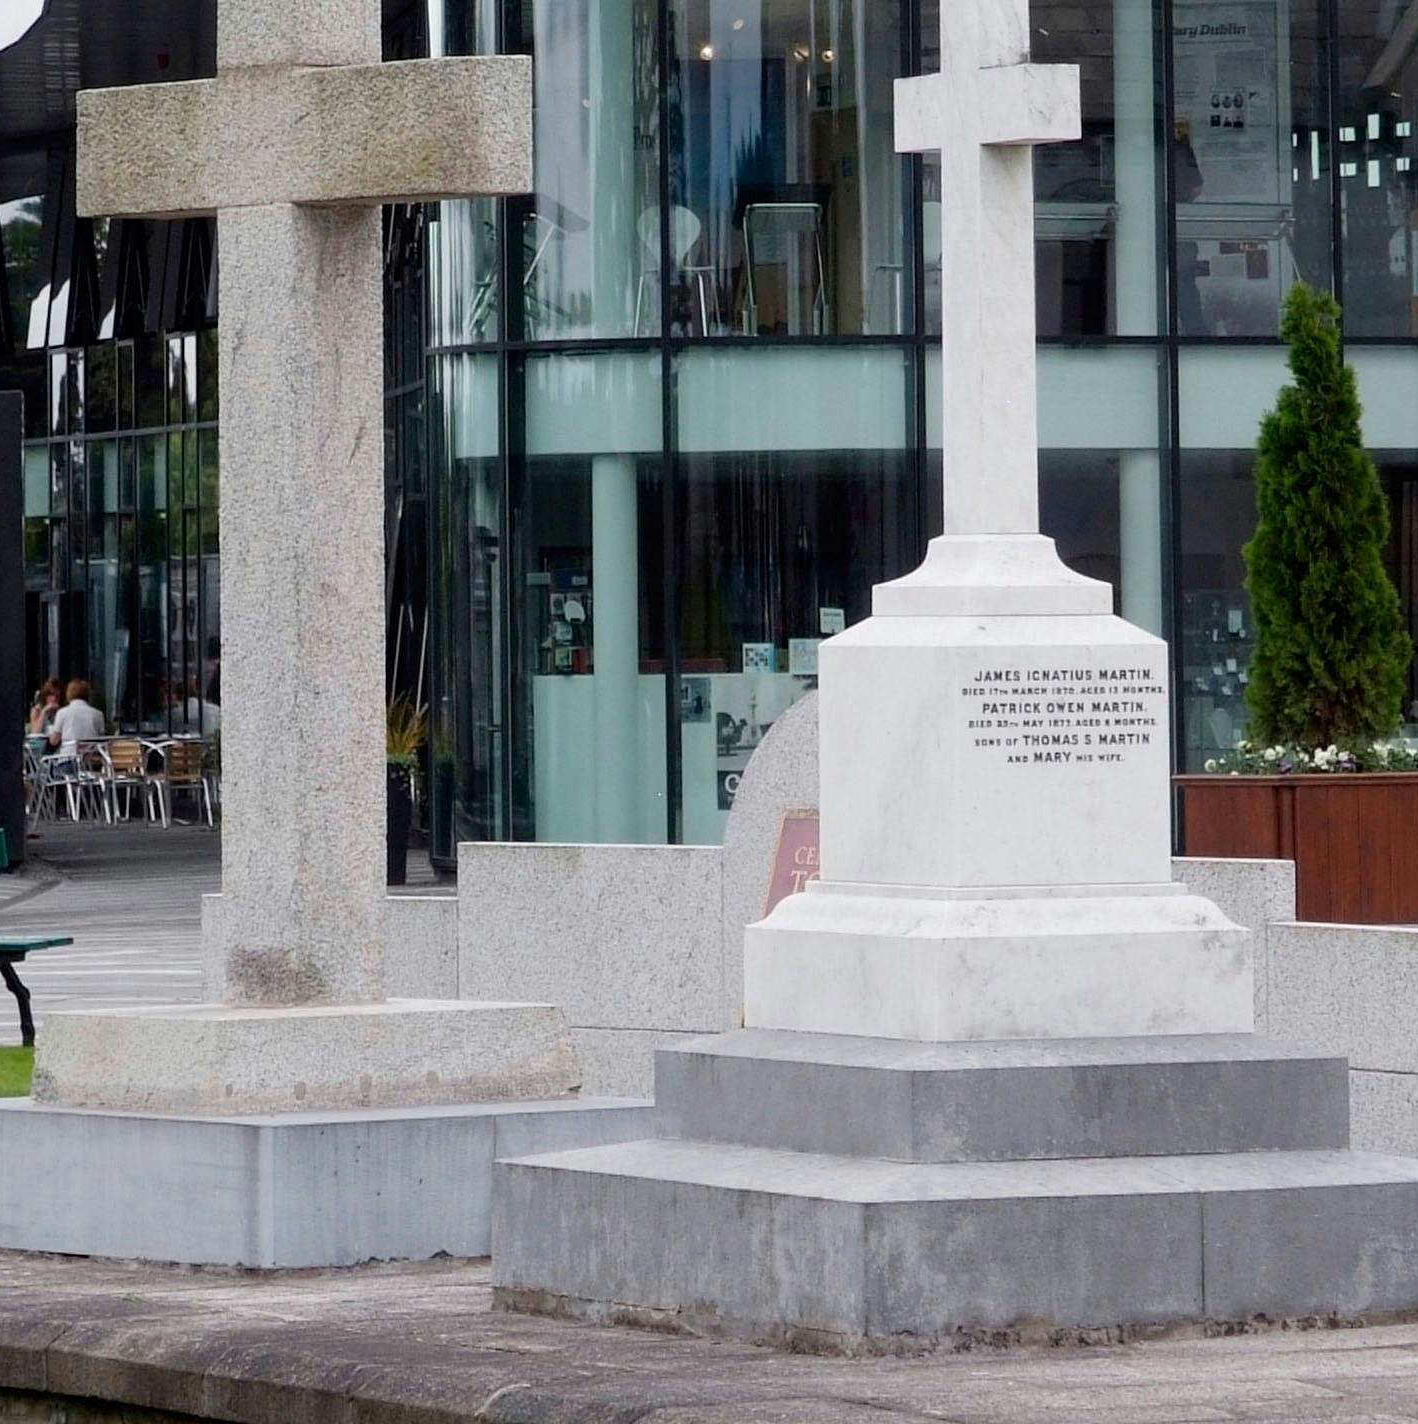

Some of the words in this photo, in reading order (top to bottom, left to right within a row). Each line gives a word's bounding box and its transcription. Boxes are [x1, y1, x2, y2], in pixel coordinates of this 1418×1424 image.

[1200, 23, 1246, 36] Dublin
[974, 670, 1021, 682] JAMES
[1027, 669, 1093, 682] IGNATIUS
[962, 688, 985, 696] DIED
[1012, 687, 1048, 695] MARCH
[1080, 686, 1106, 695] AGED
[982, 702, 1041, 714] PATRICK
[1046, 702, 1084, 714] OWEN
[969, 719, 992, 728] DIED
[1023, 719, 1044, 728] MAY
[1076, 718, 1101, 728] AGED
[975, 738, 1001, 747] SONS
[1006, 738, 1019, 747] OF
[1023, 734, 1079, 746] THOMAS
[1099, 733, 1150, 745] MARTIN
[1007, 755, 1028, 763] AND
[1033, 751, 1071, 763] MARY
[1076, 754, 1093, 762] HIS
[794, 846, 819, 865] CE
